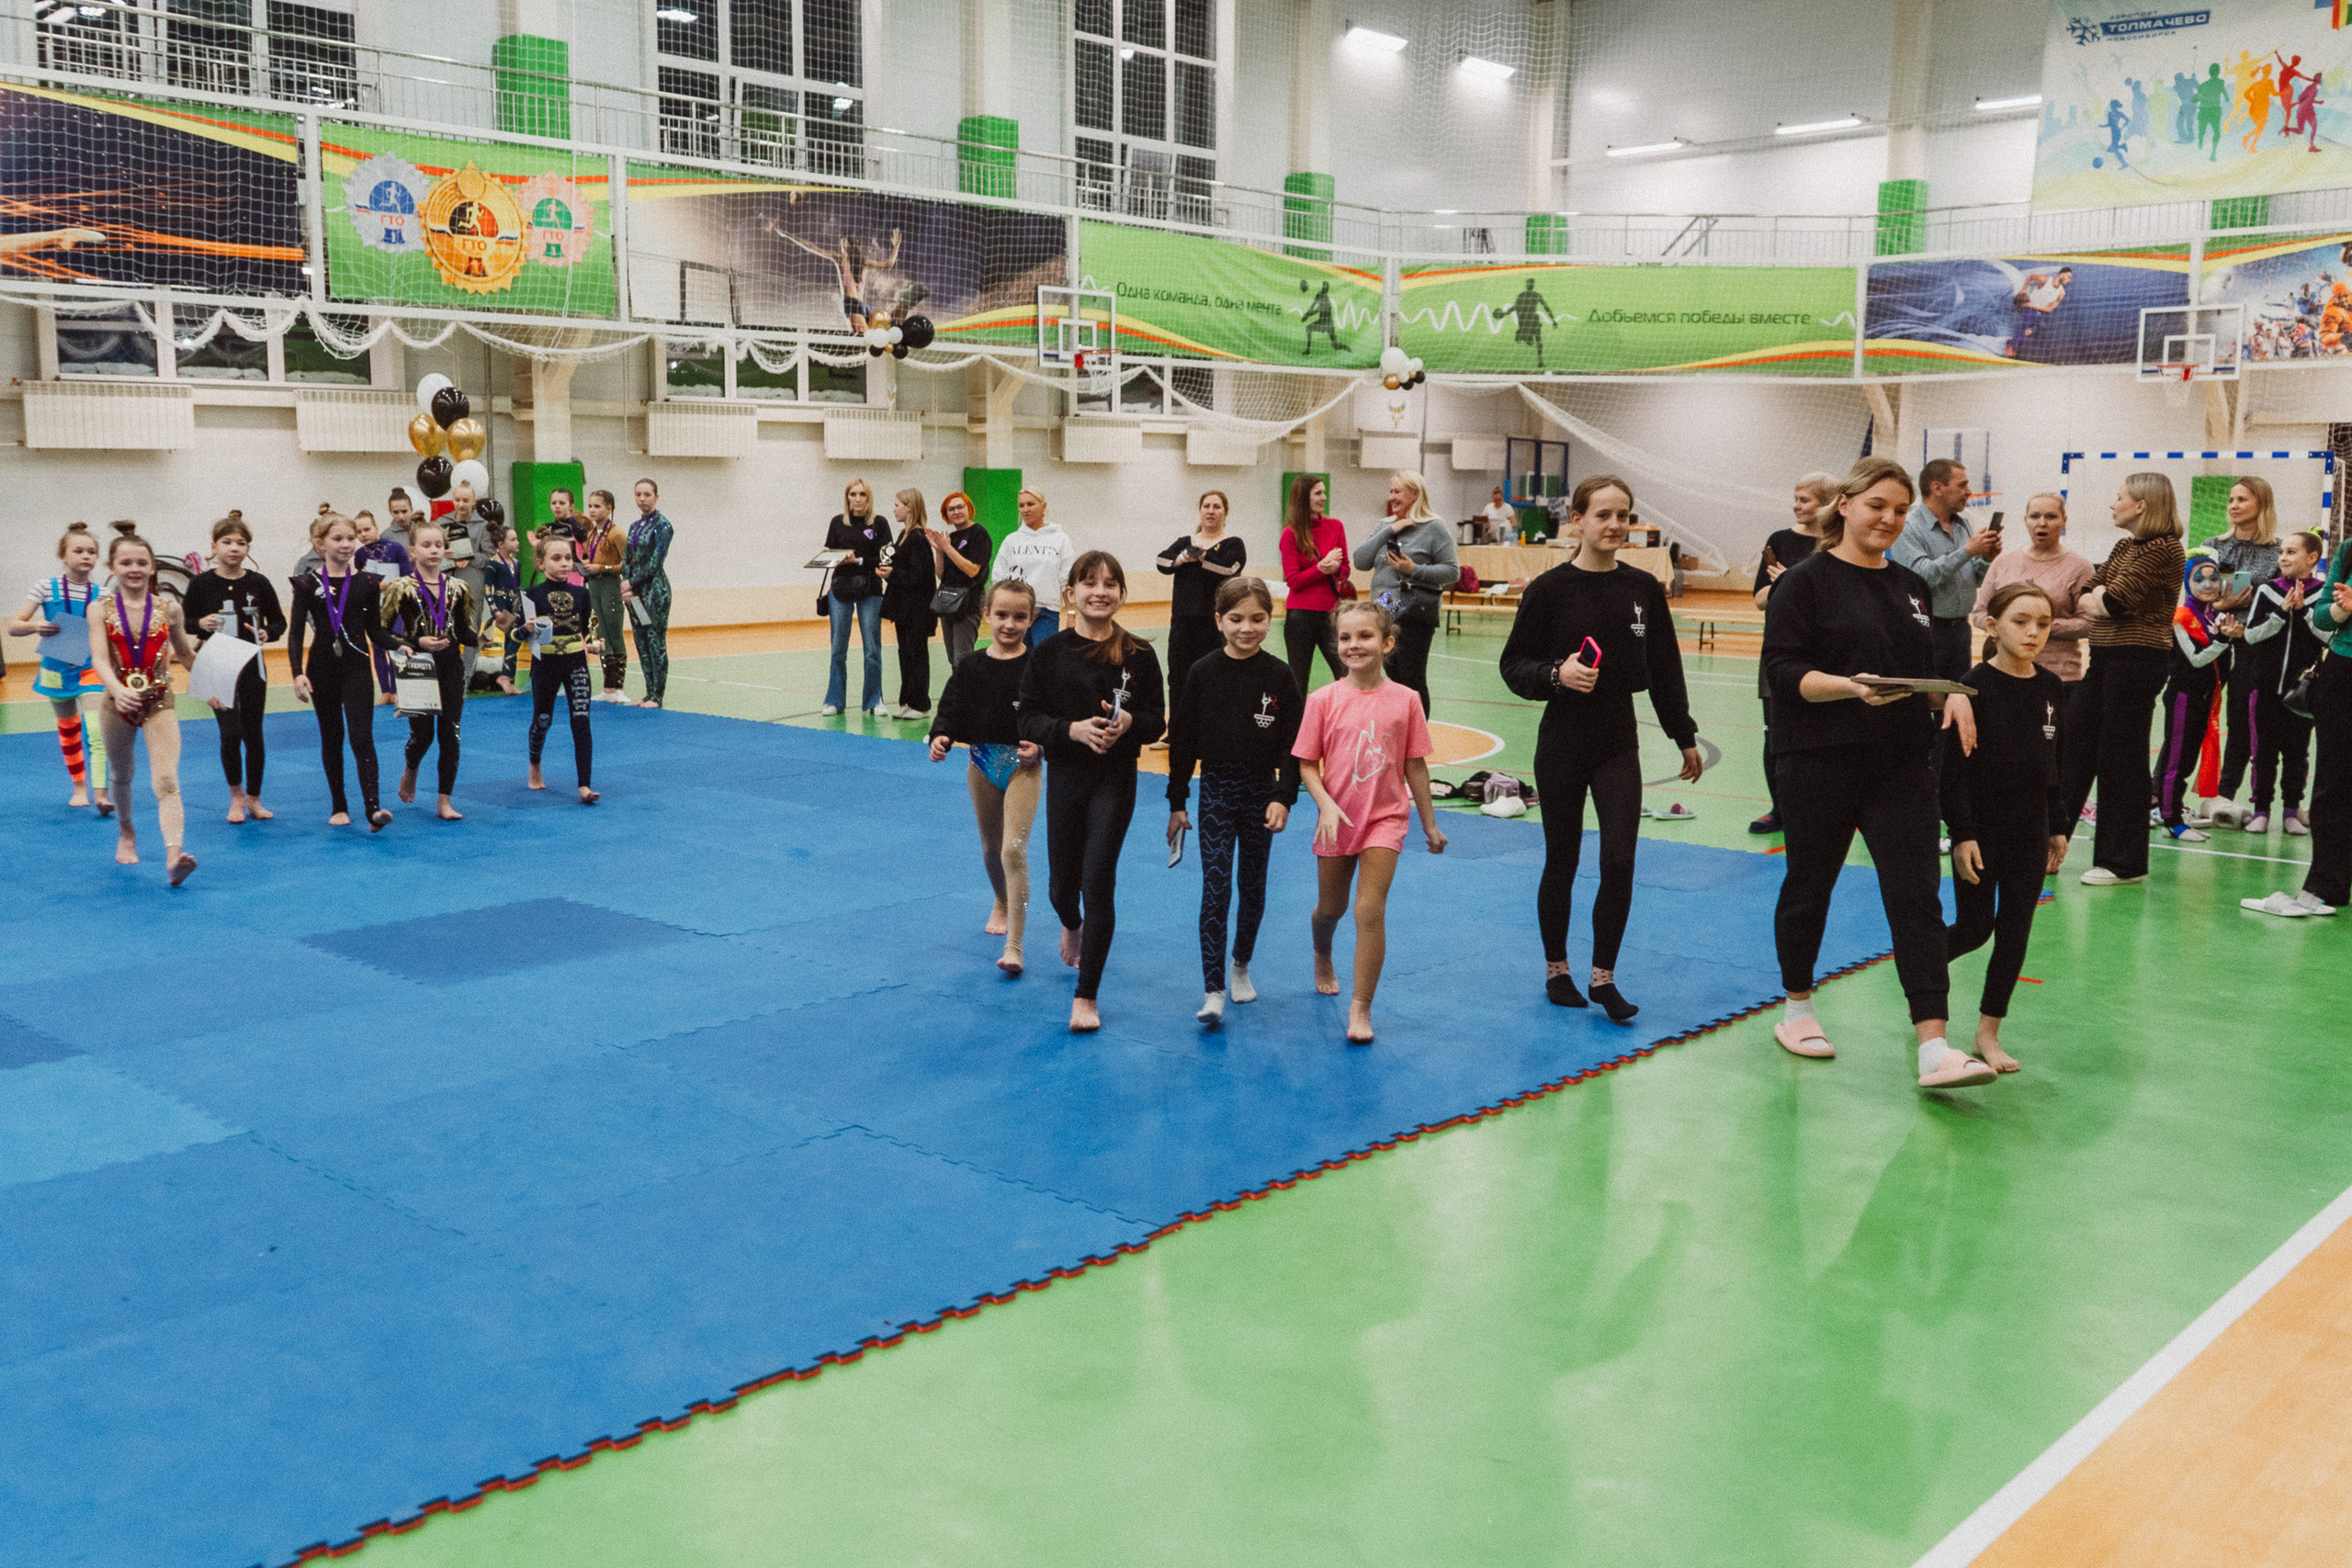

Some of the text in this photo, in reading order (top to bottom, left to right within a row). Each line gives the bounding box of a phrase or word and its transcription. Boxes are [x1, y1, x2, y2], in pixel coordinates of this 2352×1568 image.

[2108, 14, 2208, 32] ТОЛМАЧЕВО
[379, 214, 405, 227] ГТО
[543, 230, 564, 241] ГТО
[461, 239, 487, 252] ГТО
[1116, 281, 1283, 316] Одна команда, одна мечта
[1587, 308, 1811, 324] Добьемся победы вместе
